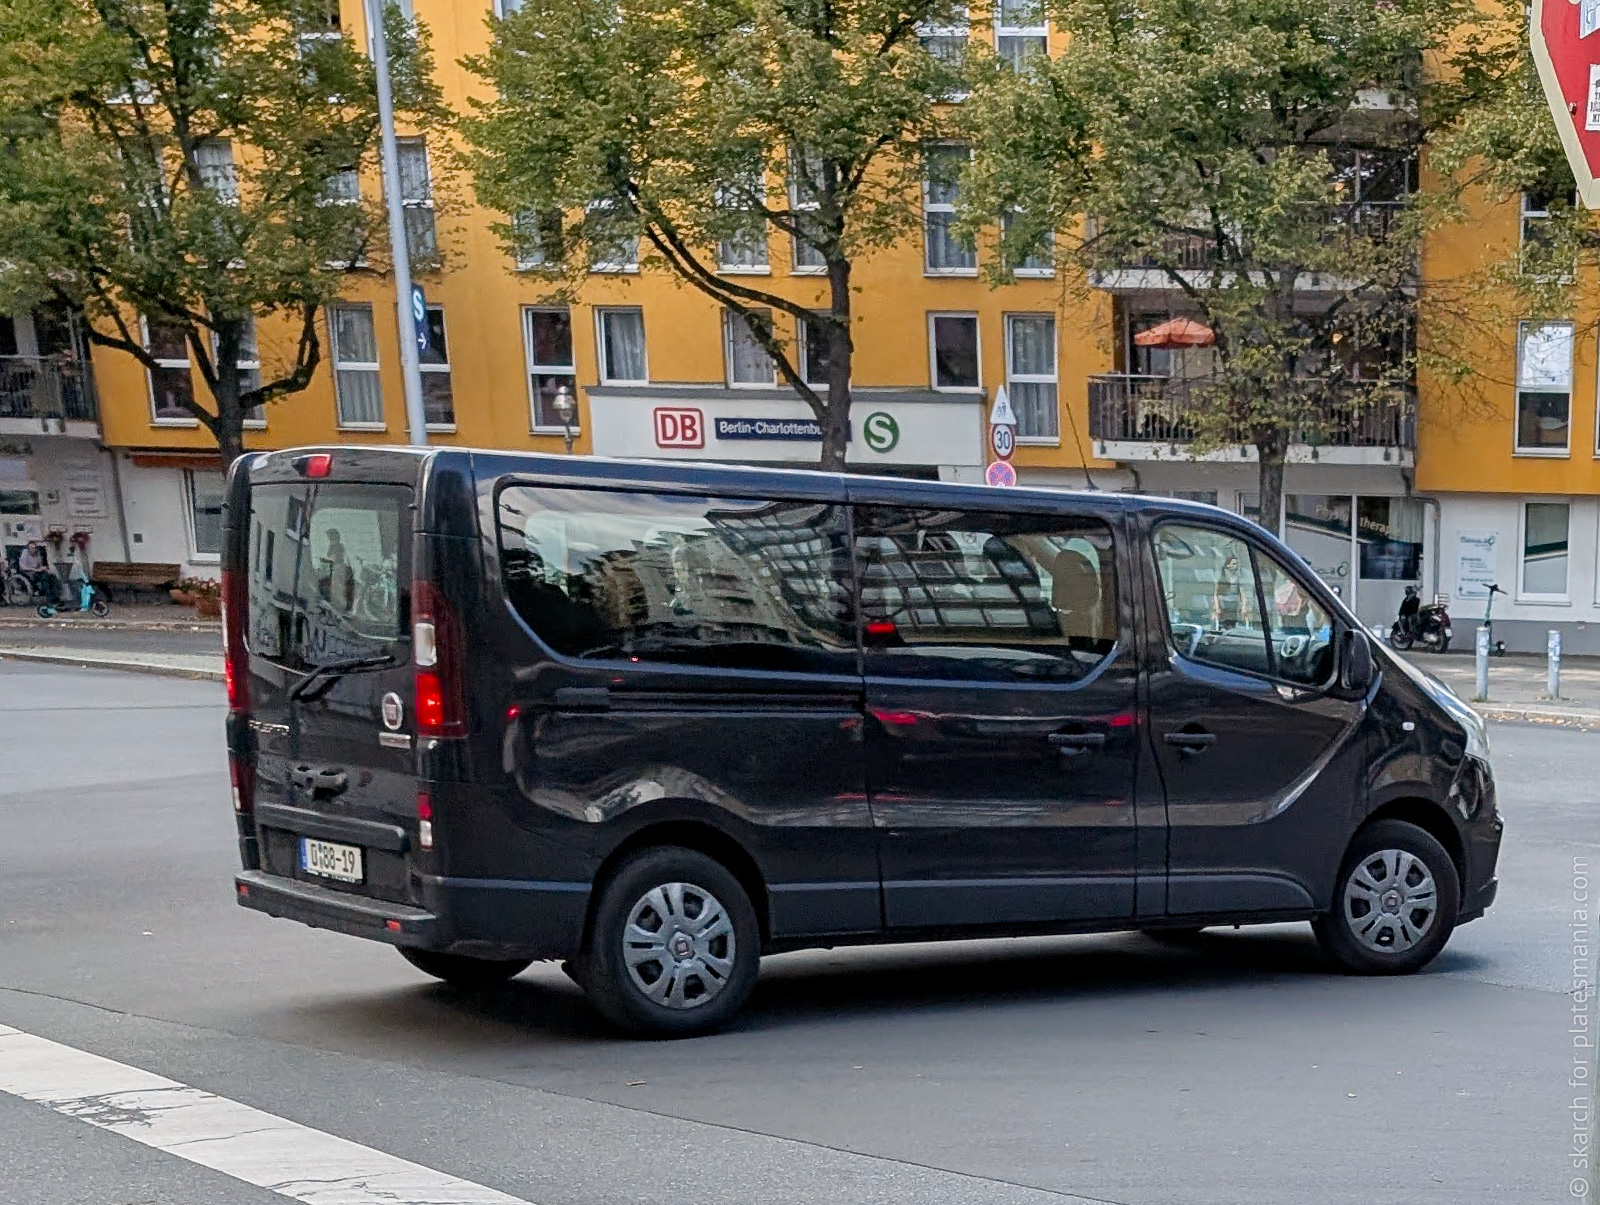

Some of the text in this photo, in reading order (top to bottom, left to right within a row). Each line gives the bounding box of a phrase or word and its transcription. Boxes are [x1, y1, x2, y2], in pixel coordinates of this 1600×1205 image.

[660, 413, 698, 441] DB
[719, 420, 823, 435] Berlin-Charlottenbu
[867, 415, 895, 449] S
[995, 430, 1011, 450] 30
